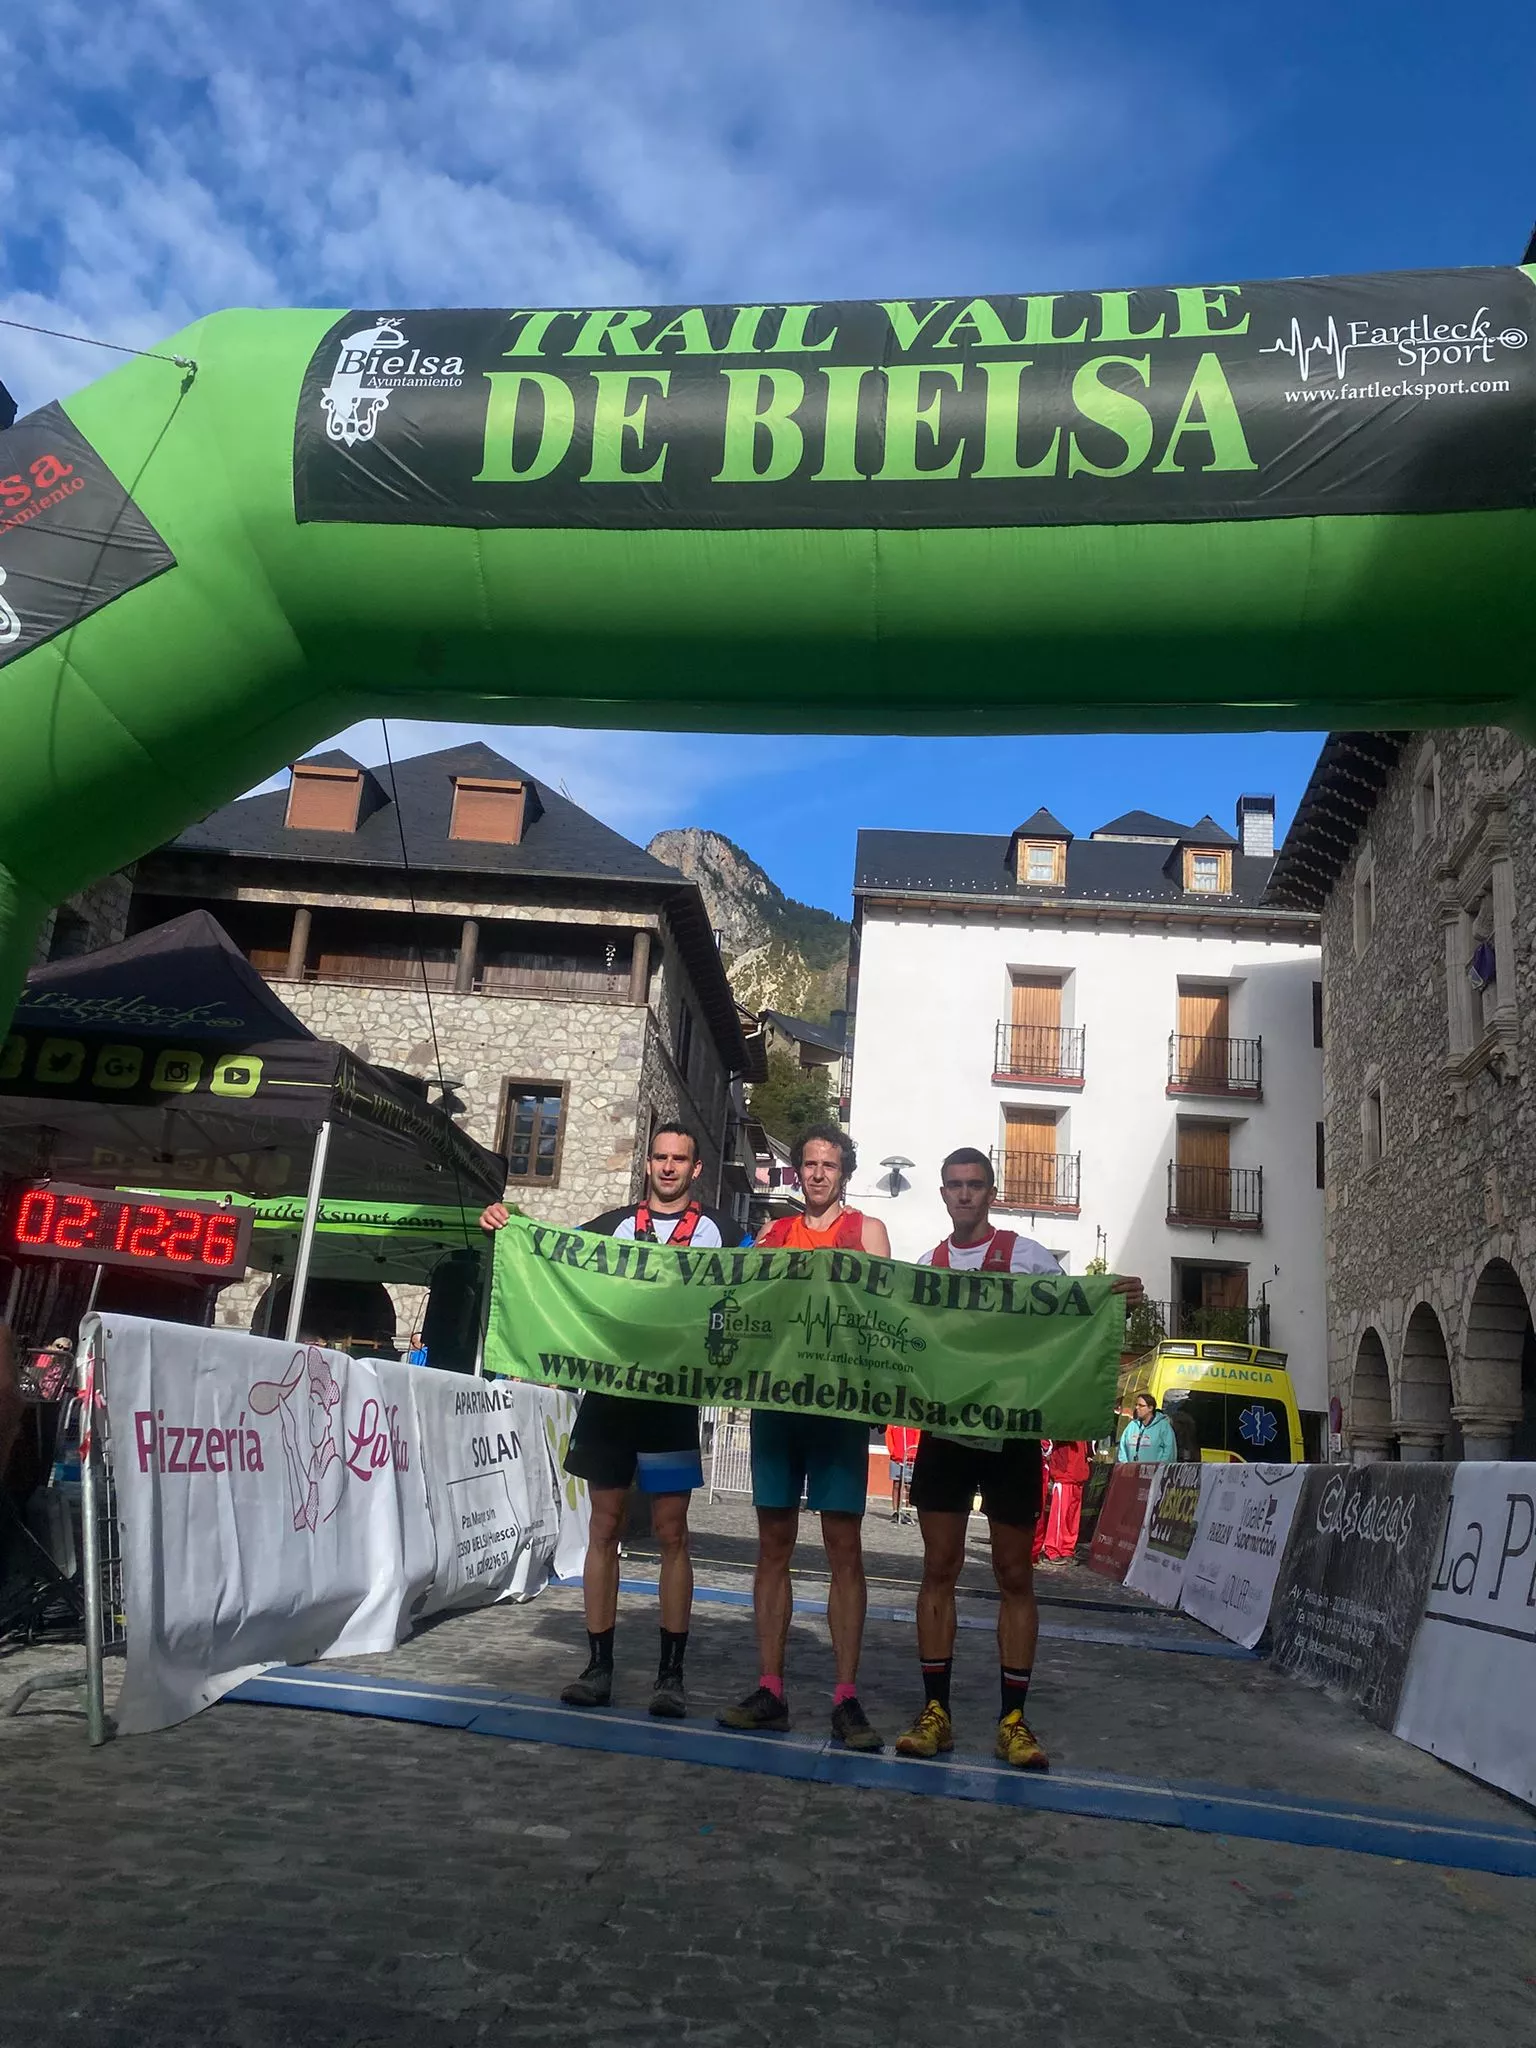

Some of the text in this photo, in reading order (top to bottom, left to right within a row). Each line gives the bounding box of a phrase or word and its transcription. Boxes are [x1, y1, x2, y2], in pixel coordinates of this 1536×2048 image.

[502, 285, 1250, 357] TRAIL VALLE
[1347, 306, 1491, 345] Fartleck
[338, 349, 465, 376] Bielsa
[1398, 334, 1496, 376] Sport
[367, 376, 463, 388] Ayuntamiento
[1284, 379, 1511, 402] www.fartlecksport.com
[471, 352, 1259, 483] DE BIELSA
[16, 1190, 236, 1266] 02:12:26
[527, 1223, 1094, 1317] TRAIL VALLE DE BIELSA
[710, 1312, 773, 1333] Bielsa
[835, 1304, 910, 1337] Fartleck
[858, 1325, 909, 1353] Sport
[797, 1350, 914, 1374] www.fartlecksport.com
[538, 1352, 1043, 1433] www.trailvalledebielsa.com
[134, 1409, 264, 1473] Pizzería
[346, 1398, 390, 1481] La
